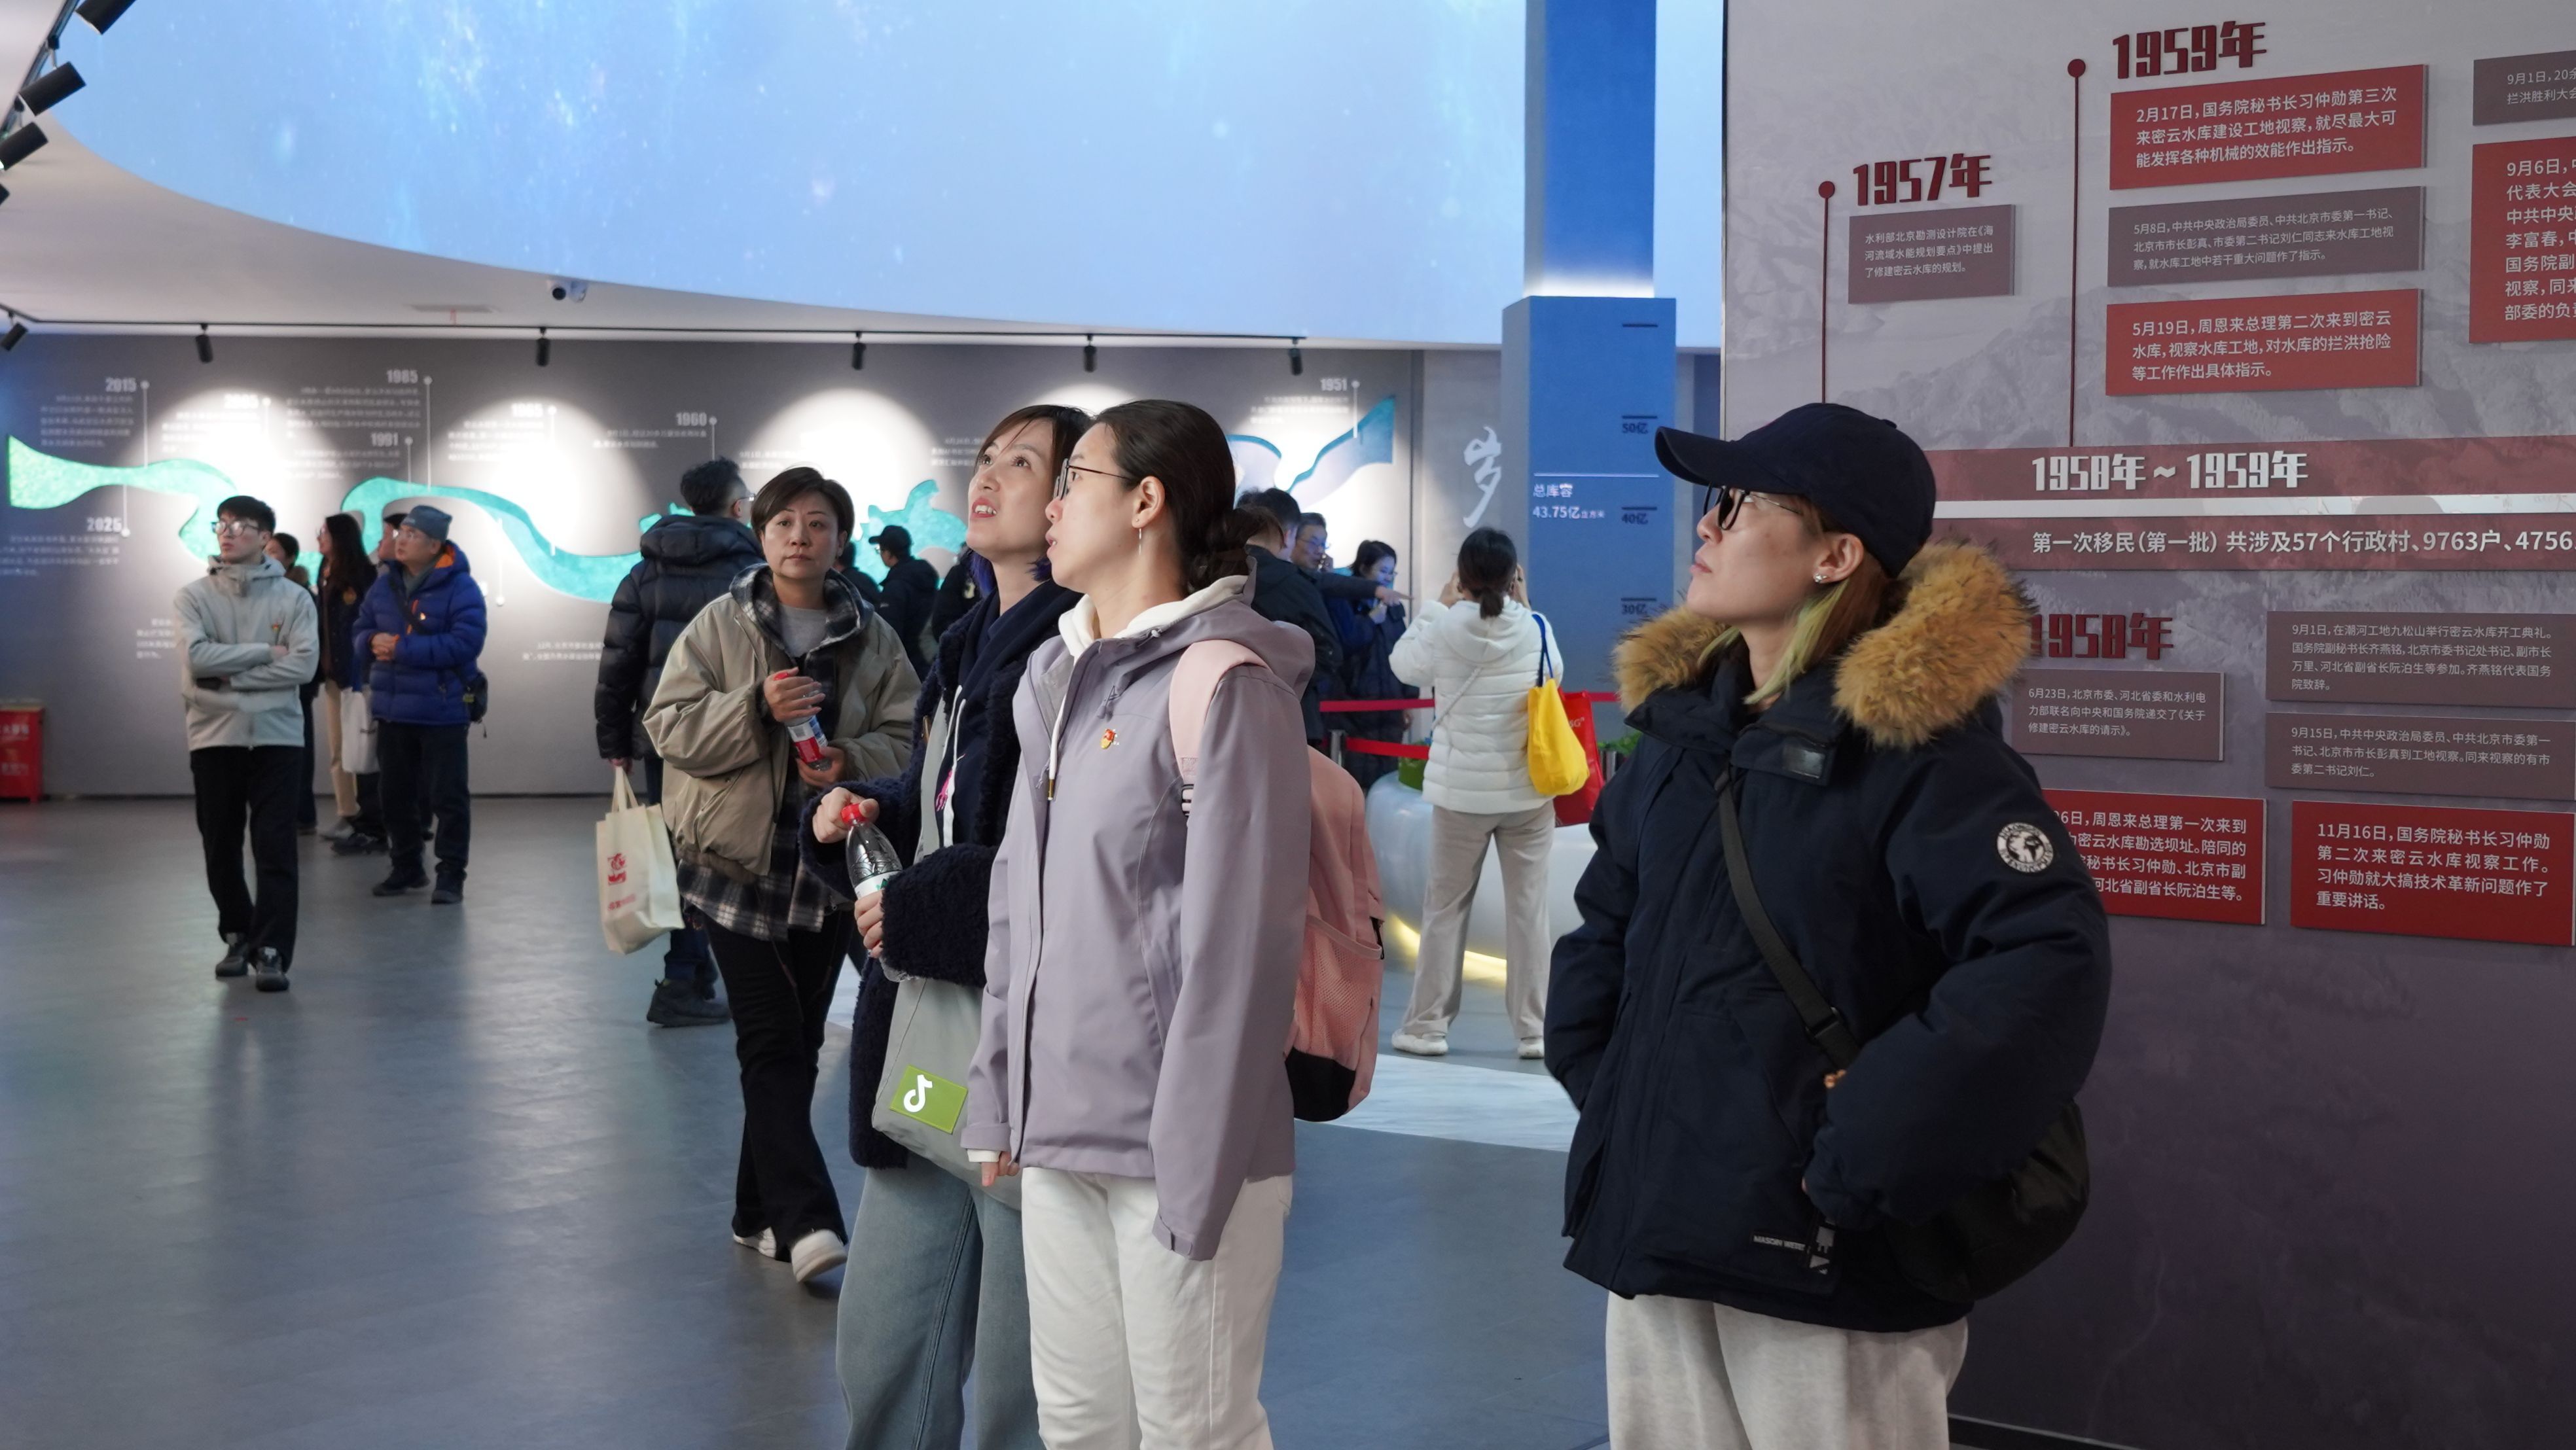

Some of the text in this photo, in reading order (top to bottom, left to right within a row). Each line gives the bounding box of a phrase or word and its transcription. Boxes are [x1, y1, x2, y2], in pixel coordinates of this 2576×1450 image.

[2111, 20, 2268, 80] 1959年
[2136, 86, 2397, 124] 2月17日，国务院秘书长习仲勋第三次
[2507, 87, 2576, 105] 拦洪胜利大会
[2136, 109, 2397, 147] 来密云水库建设工地视察，就尽最大可
[2136, 138, 2355, 168] 能发挥各种机械的效能作出指示。
[1853, 152, 1992, 206] 1957年
[2507, 181, 2576, 202] 代表大会
[2134, 208, 2393, 236] 5月8日，中共中央政治局委员、中共北京市委第一书记、
[2506, 205, 2576, 225] 中共中央
[1865, 224, 1994, 245] 水利部北京勘测设计院在《海
[2134, 226, 2393, 253] 北京市市长彭真、市委第二书记刘仁同志来水库工地视
[1865, 242, 1994, 261] 河流域水能规划要点》中提出
[2133, 249, 2326, 271] 察，就水库工地中若干重大问题作了指示。
[1864, 262, 1966, 278] 了修建密云水库的规划。
[2505, 254, 2575, 274] 国务院副
[2504, 302, 2576, 321] 部委的负
[2132, 311, 2391, 336] 5月19日，周恩来总理第二次来到密云
[2132, 334, 2391, 359] 水库，视察水库工地，对水库的拦洪抢险
[2132, 362, 2272, 382] 等工作作出具体指示。
[1320, 378, 1348, 391] 1951
[675, 412, 707, 426] 1960
[1533, 483, 1573, 498] 总库容
[2030, 612, 2174, 660] 1958年
[2292, 624, 2552, 639] 9月1日，在潮河工地九松山举行密云水库开工典礼。
[2292, 641, 2552, 658] 国务院副秘书长齐燕铭，北京市委书记处书记、副市长
[2291, 660, 2551, 677] 万里、河北省副省长阮泊生等参加。齐燕铭代表国务
[2291, 678, 2330, 691] 院致辞。
[2028, 688, 2206, 703] 6月23日，北京市委、河北省委和水利电
[2028, 705, 2206, 722] 力部联名向中央和国务院递交了《关于
[2028, 722, 2131, 737] 修建密云水库的请示》。
[2291, 726, 2551, 745] 9月15日，中共中央政治局委员、中共北京市委第一
[2291, 745, 2550, 766] 书记、北京市市长彭真到工地视察。同来视察的有市
[2291, 763, 2376, 778] 委第二书记刘仁。
[2317, 822, 2550, 850] 11月16日，国务院秘书长习仲勋
[2317, 845, 2549, 874] 第二次来密云水库视察工作。
[2317, 868, 2549, 897] 习仲勋就大搞技术革新问题作了
[2316, 890, 2386, 911] 重要讲话。
